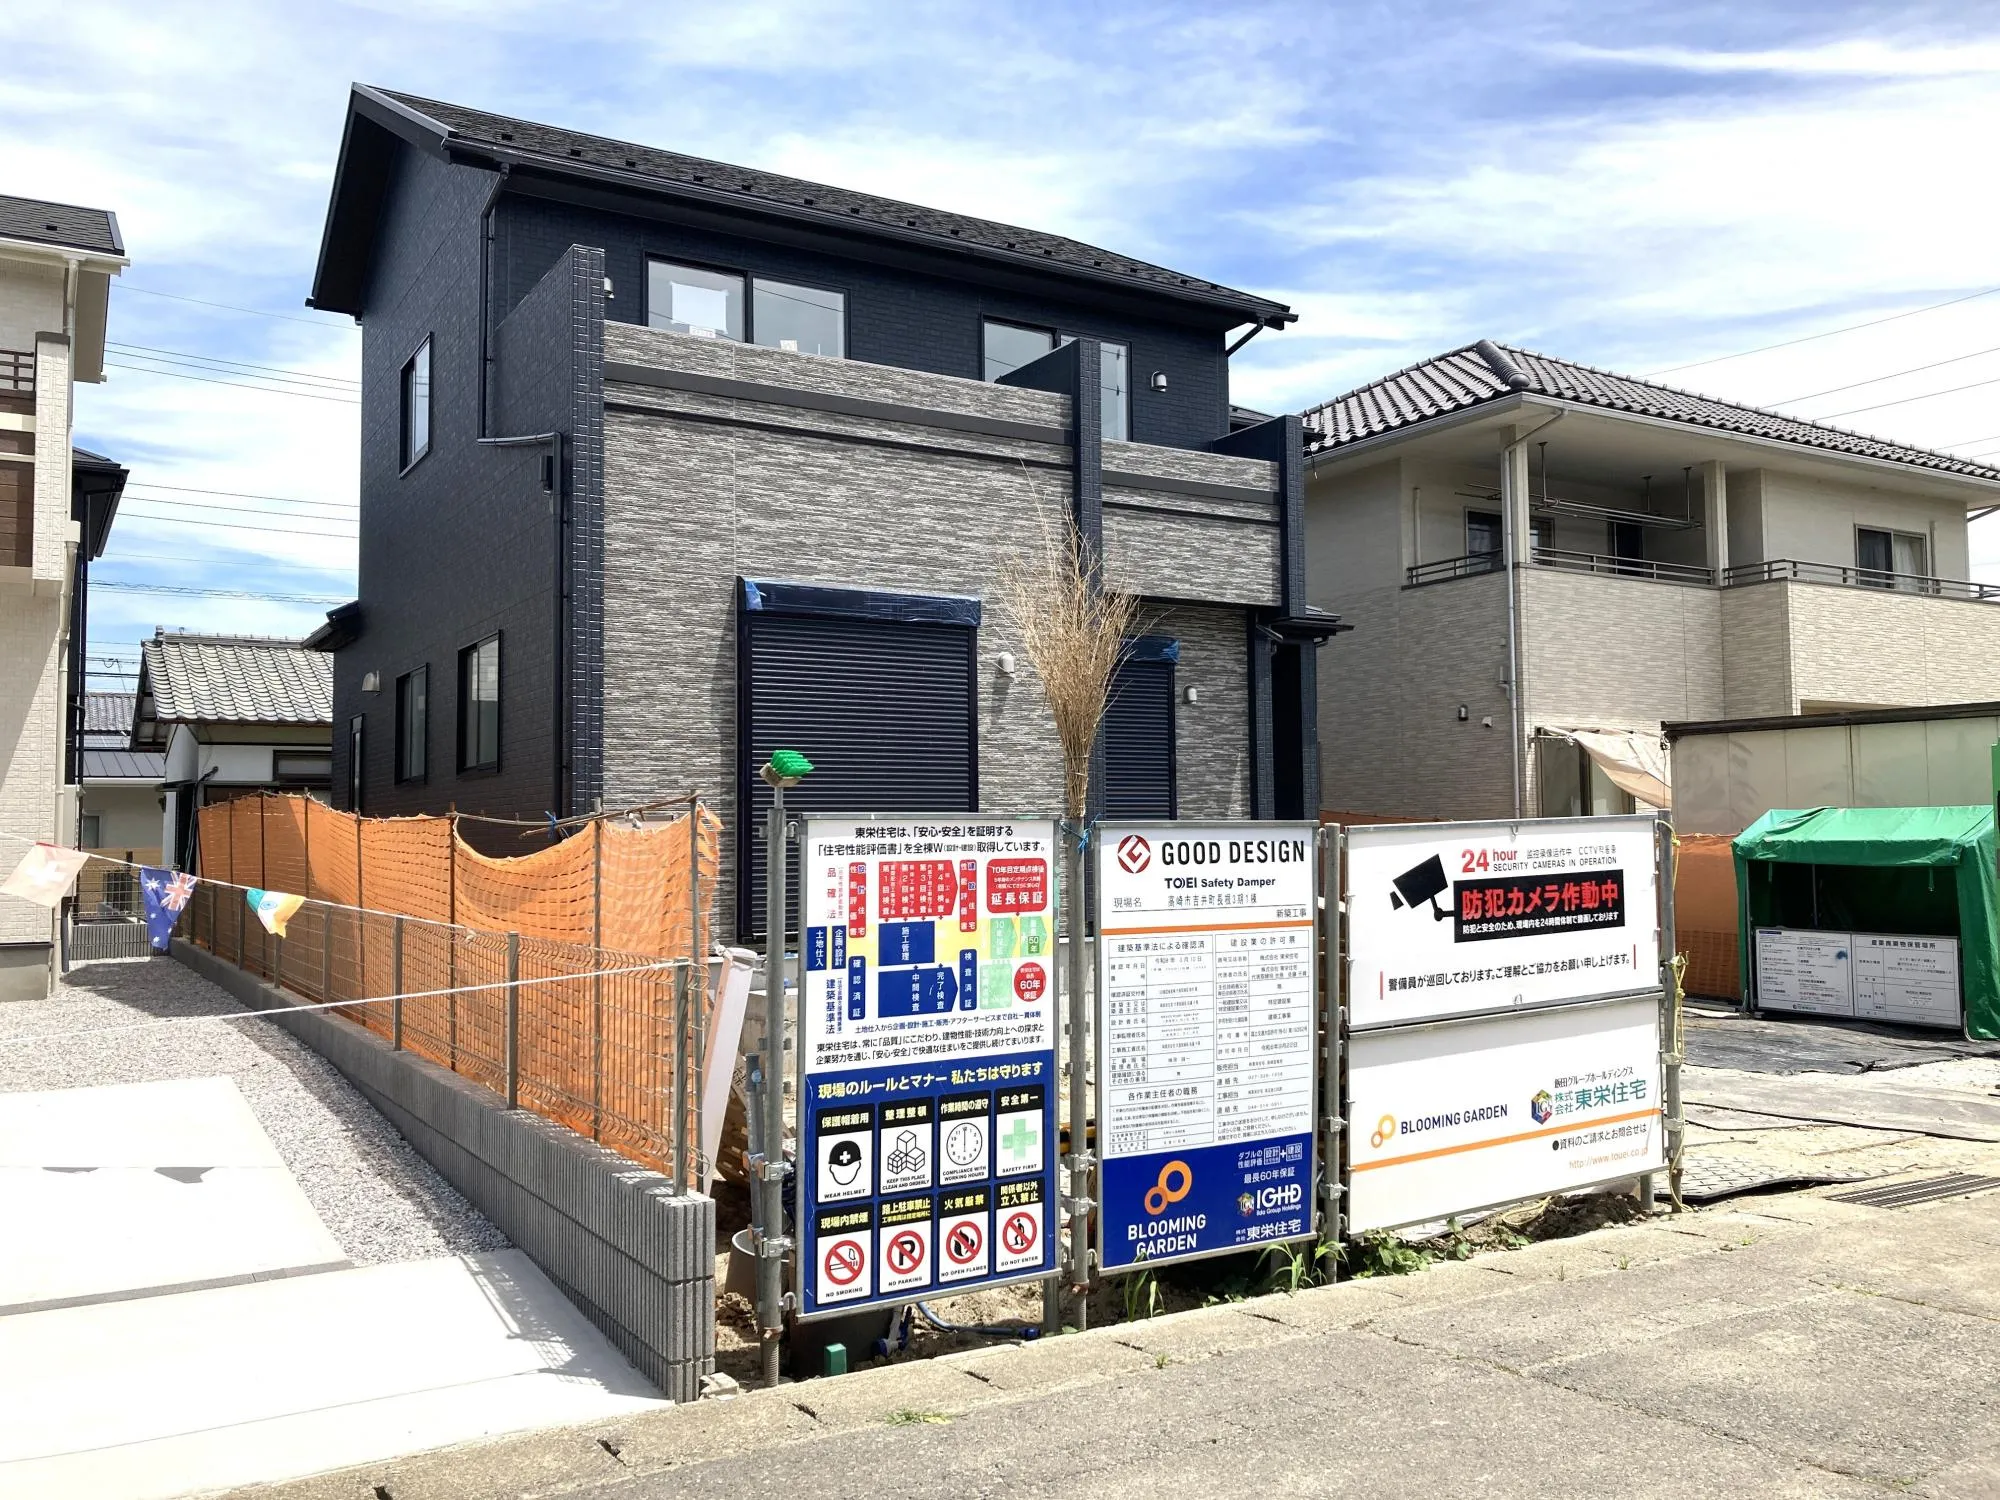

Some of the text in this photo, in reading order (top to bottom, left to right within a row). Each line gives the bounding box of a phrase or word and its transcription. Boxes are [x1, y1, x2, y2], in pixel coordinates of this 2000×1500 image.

[1162, 840, 1305, 866] GOOD DESIGN
[1461, 849, 1518, 873] 24 hour
[1493, 856, 1617, 872] SECURITY CAMERAS IN OPERATION
[1201, 878, 1233, 889] Safety
[1237, 877, 1276, 889] Damper
[991, 891, 1044, 905] 延長保証
[1114, 897, 1142, 908] 現場名
[1461, 879, 1619, 921] 防犯カメラ作動中
[1276, 908, 1307, 918] 新築工事
[815, 929, 824, 967] 土地仕入
[901, 926, 910, 961] 施工管理
[1117, 940, 1205, 953] 建築基準法による確認済
[964, 952, 972, 1008] 検査済証
[853, 959, 861, 1017] 確認済証
[936, 972, 944, 1010] 完了検査
[818, 1061, 1043, 1099] 現場のルールとマナー 私たちは守ります
[1001, 1093, 1039, 1107] 安全第一
[1128, 1086, 1198, 1101] 各作業主任者の職務
[1217, 1091, 1239, 1100] 工事担当
[1555, 1090, 1573, 1102] 株式
[1575, 1079, 1647, 1111] 東栄住宅
[1555, 1103, 1573, 1115] 会社
[1400, 1103, 1508, 1135] BLOOMING GARDEN
[1238, 1150, 1262, 1160] ダブルの
[942, 1168, 973, 1176] COMPLIANCE
[1002, 1165, 1021, 1173] SAFETY
[1244, 1167, 1295, 1184] 最長60年保証
[842, 1188, 866, 1196] HELMET
[1000, 1181, 1038, 1195] 関係者以外
[944, 1194, 984, 1210] 火気厳禁
[1000, 1191, 1039, 1207] 立入禁止
[1266, 1207, 1281, 1215] Group
[820, 1212, 869, 1229] 現場内禁煙
[1127, 1214, 1207, 1241] BLOOMING
[1246, 1218, 1302, 1241] 東栄住宅
[1136, 1233, 1197, 1257] GARDEN
[965, 1265, 987, 1273] FLAMES
[898, 1276, 922, 1285] PARKING
[836, 1287, 863, 1296] SMOKING
